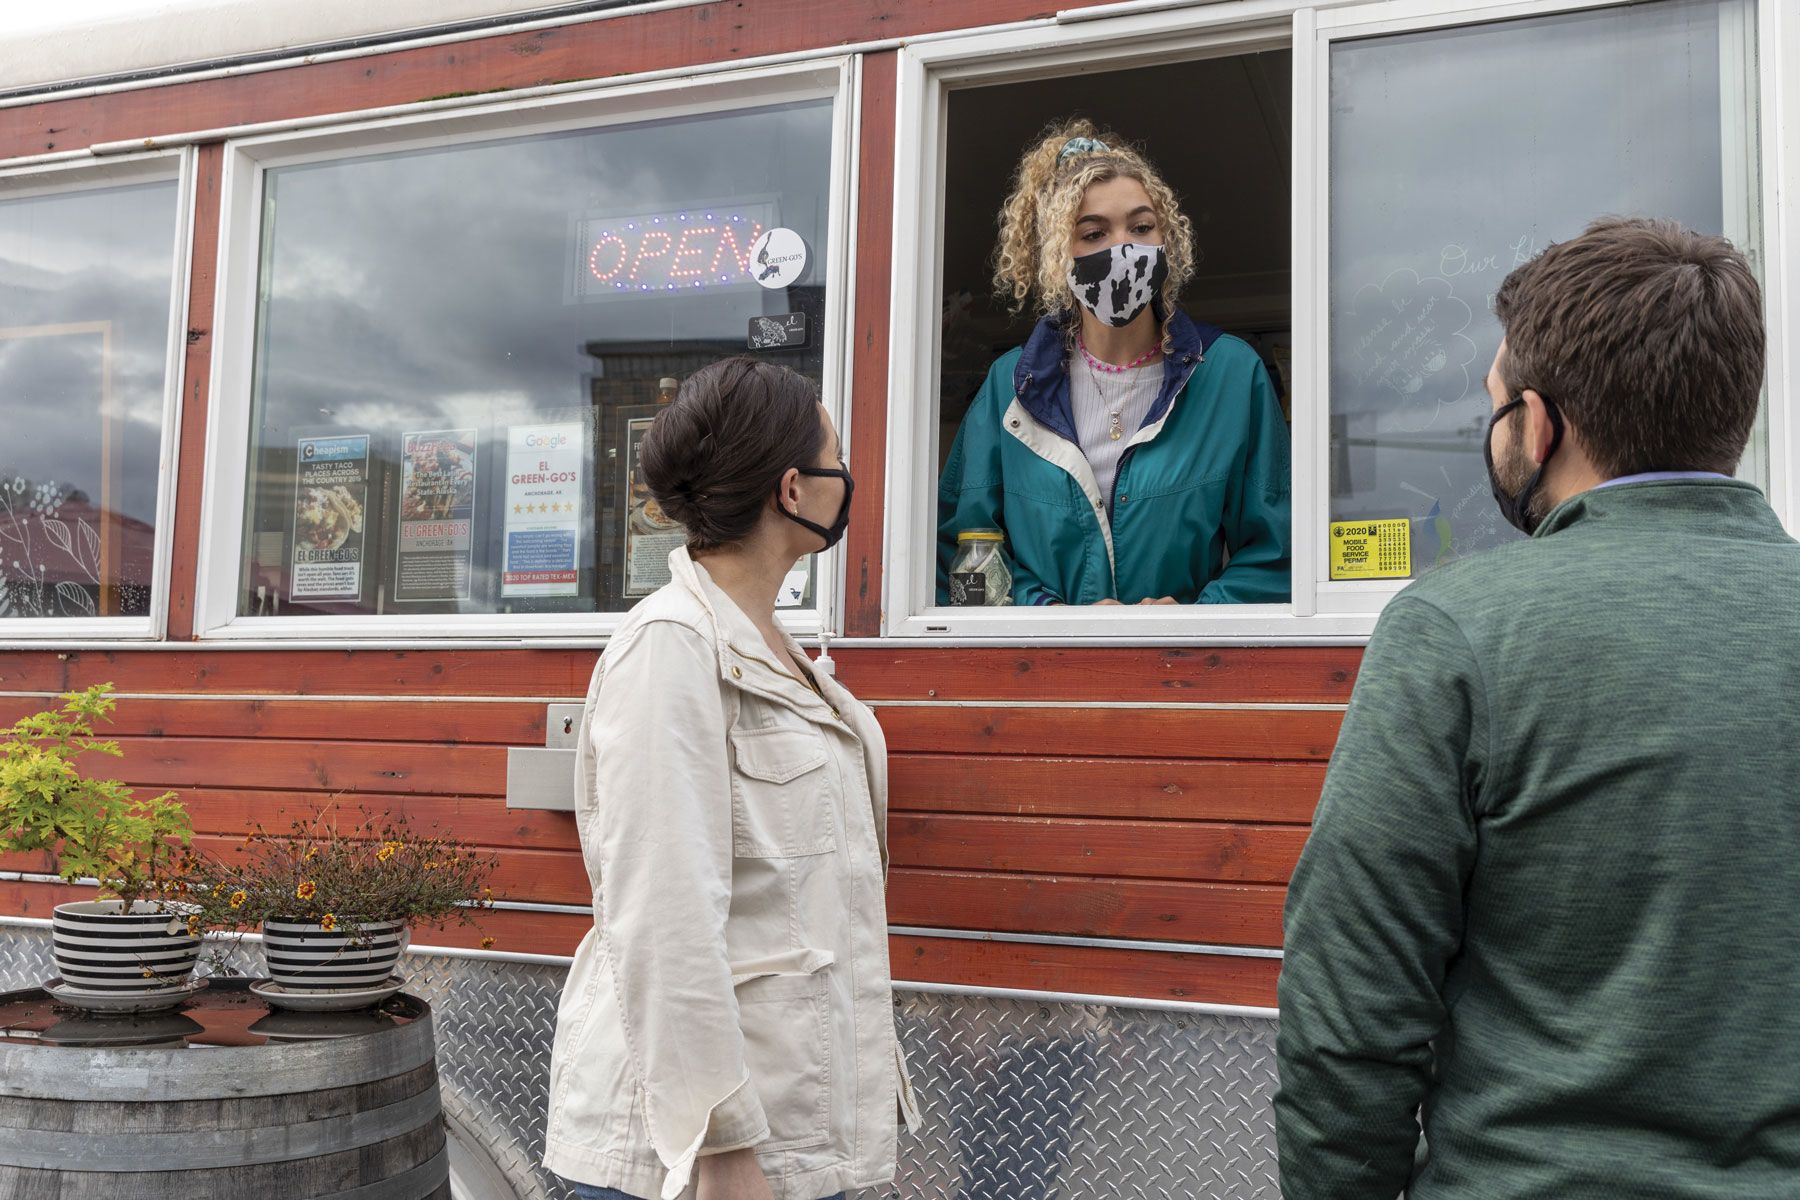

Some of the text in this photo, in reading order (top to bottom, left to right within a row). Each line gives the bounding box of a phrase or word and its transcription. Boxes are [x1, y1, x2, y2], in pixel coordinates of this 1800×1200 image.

[589, 224, 762, 281] OPEN
[1440, 243, 1499, 277] Our
[526, 432, 567, 449] Google
[305, 444, 349, 457] Cheapism
[312, 463, 333, 471] TASTY
[539, 461, 550, 471] EL
[304, 468, 360, 478] PLACES ACROSS
[511, 472, 576, 485] GREEN-GO'S
[316, 476, 348, 484] COUNTRY
[404, 523, 467, 538] EL GREEN-GO'S
[1346, 527, 1367, 536] 2020
[298, 547, 358, 561] EL GREEN-GO'S
